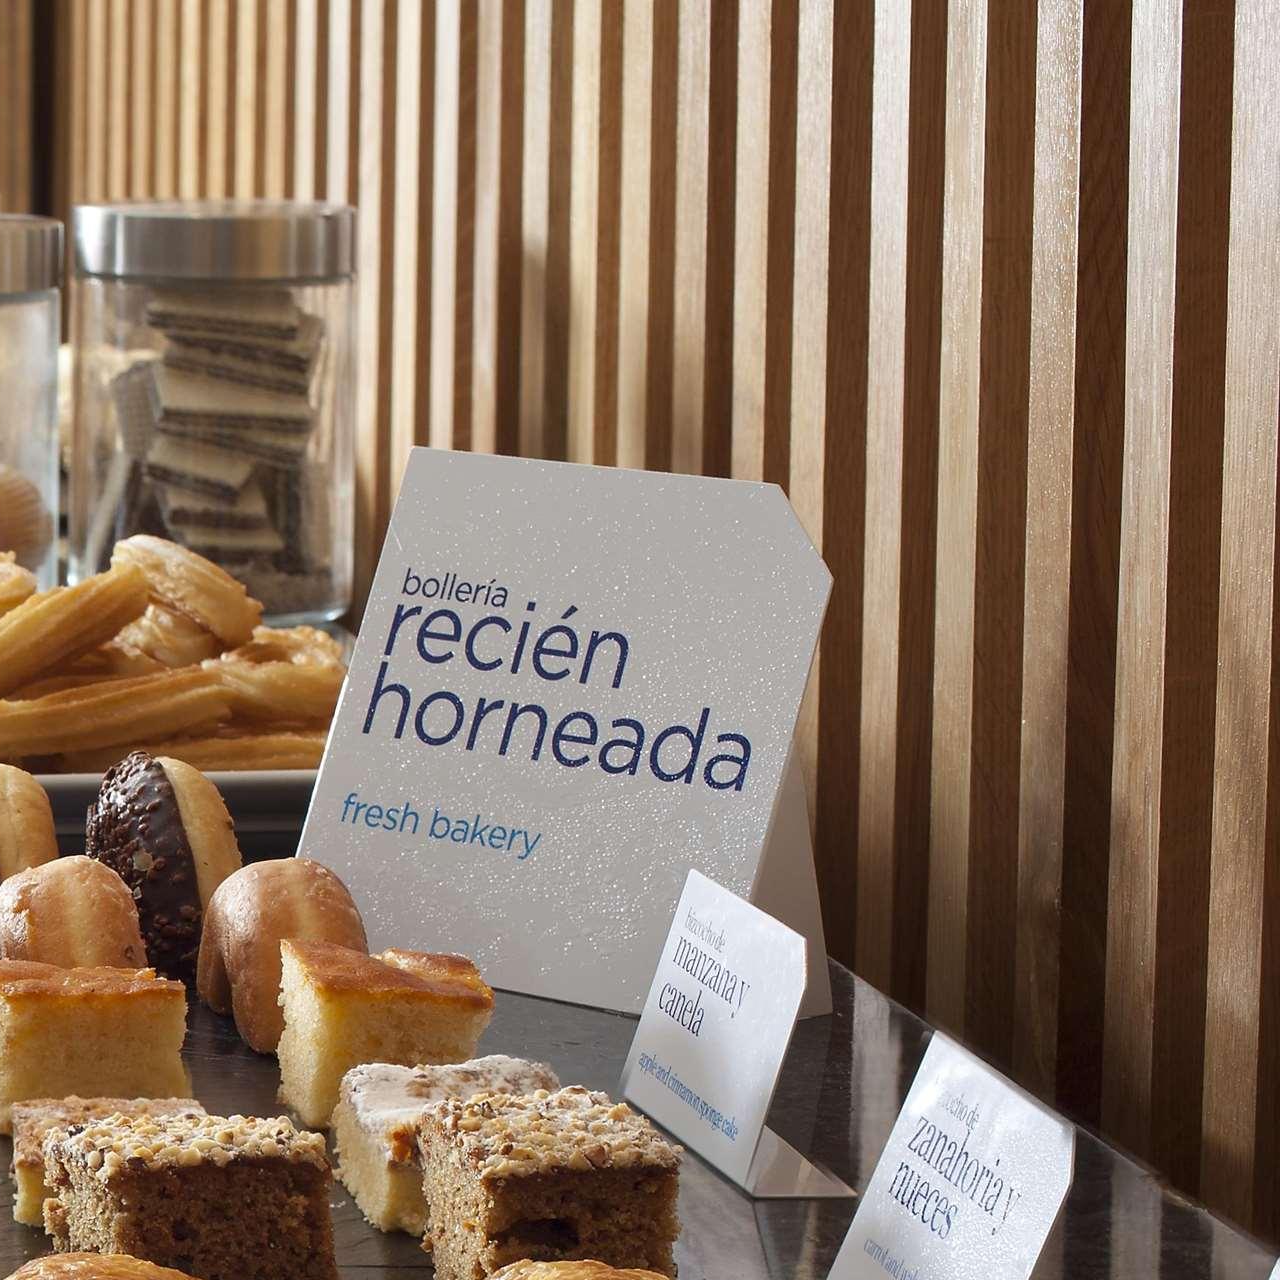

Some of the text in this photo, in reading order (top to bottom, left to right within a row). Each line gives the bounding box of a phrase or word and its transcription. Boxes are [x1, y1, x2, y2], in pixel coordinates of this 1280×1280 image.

[402, 568, 508, 608] bollería
[384, 601, 630, 688] recién
[362, 661, 752, 791] horneada
[341, 793, 541, 860] fresh bakery
[658, 982, 705, 1037] canela
[672, 936, 751, 1019] manzana y
[888, 1161, 958, 1239] nueces
[907, 1116, 1022, 1236] zanahoria y
